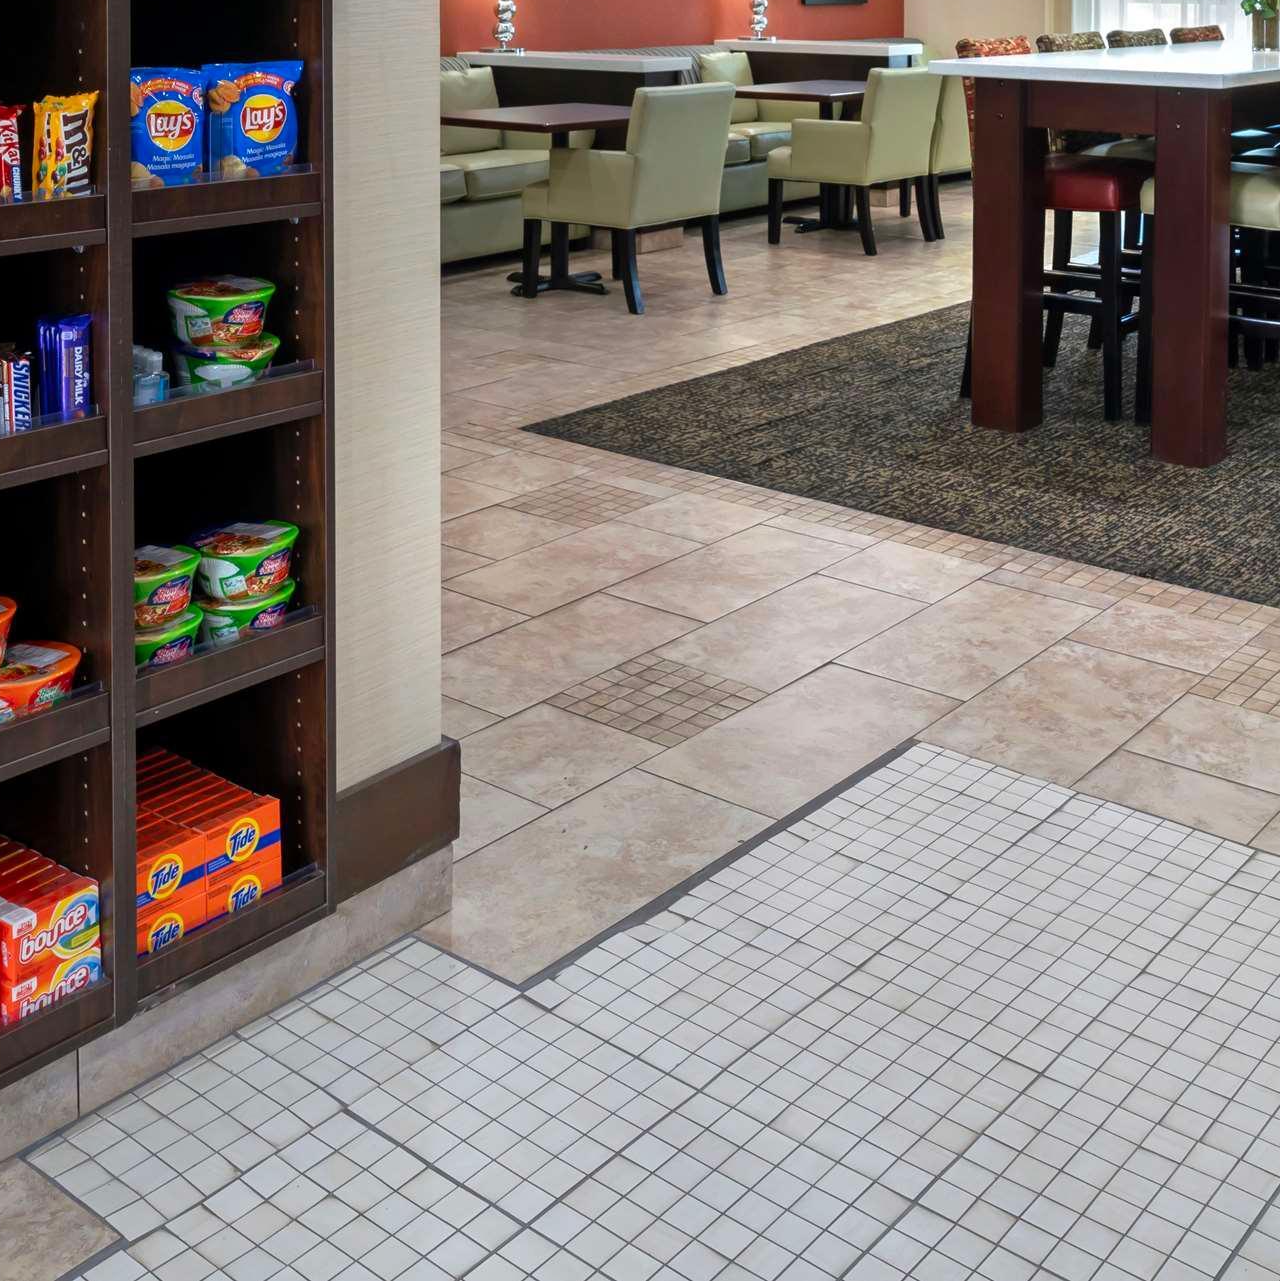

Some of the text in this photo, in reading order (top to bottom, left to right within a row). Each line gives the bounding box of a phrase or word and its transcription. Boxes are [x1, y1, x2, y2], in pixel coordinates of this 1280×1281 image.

[149, 111, 192, 139] Lay's
[246, 104, 284, 132] Lay's
[74, 346, 84, 405] DAIRY MILK
[229, 826, 256, 858] Tide
[151, 863, 180, 894] Tide
[231, 884, 259, 913] Tide
[20, 902, 88, 963] bounce
[151, 922, 181, 952] Tide
